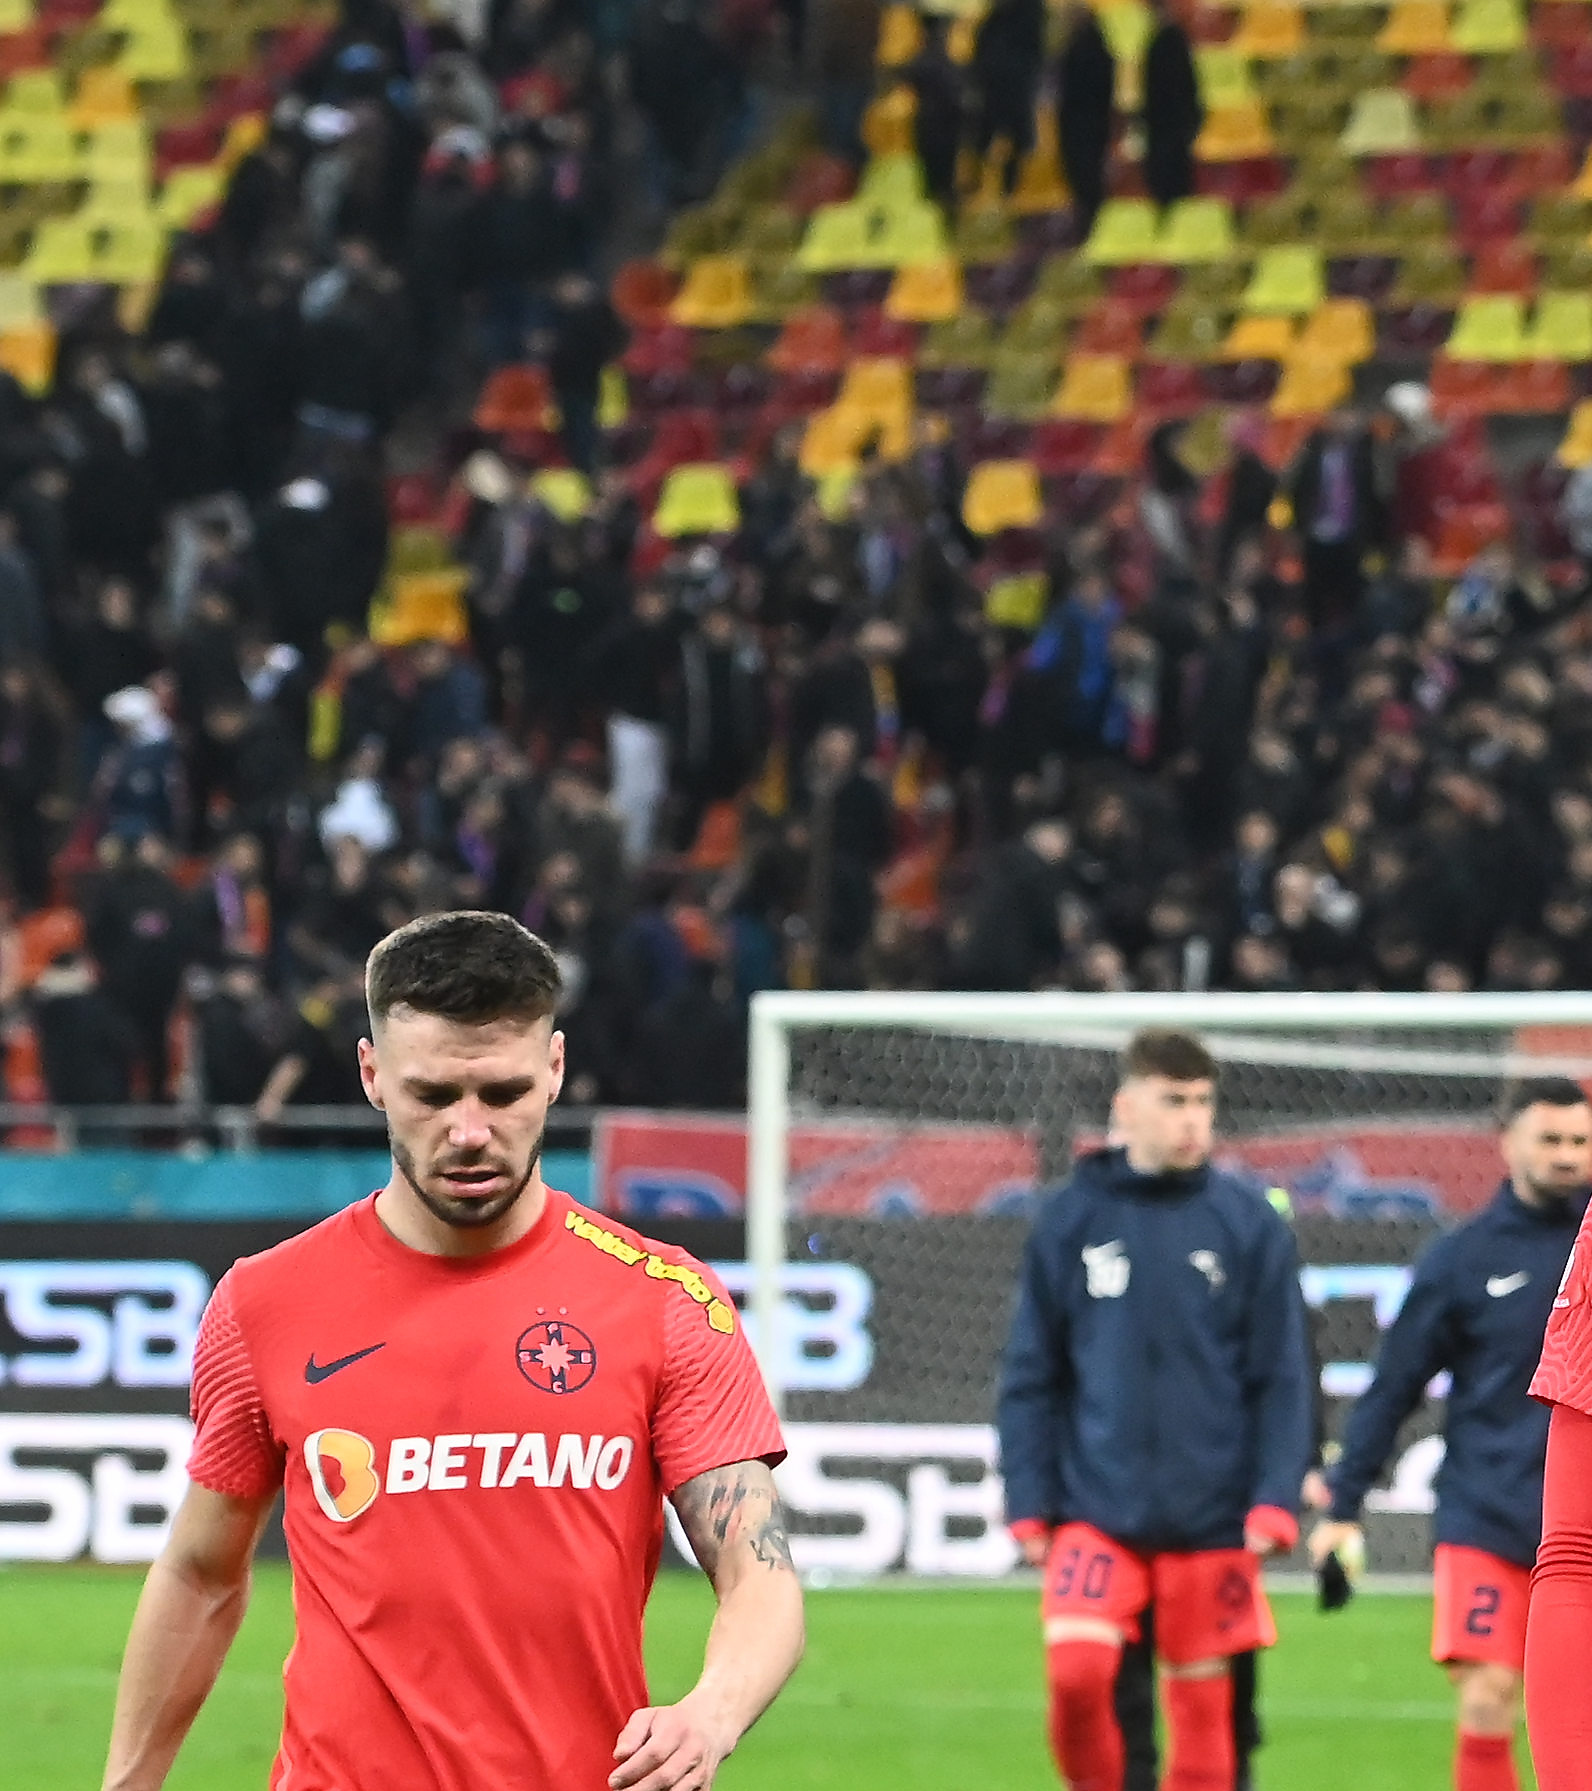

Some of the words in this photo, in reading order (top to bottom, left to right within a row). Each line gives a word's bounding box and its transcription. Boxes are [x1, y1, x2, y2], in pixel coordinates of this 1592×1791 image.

[0, 1259, 209, 1388] SB
[385, 1432, 634, 1495] BETANO
[1466, 1586, 1500, 1635] 2
